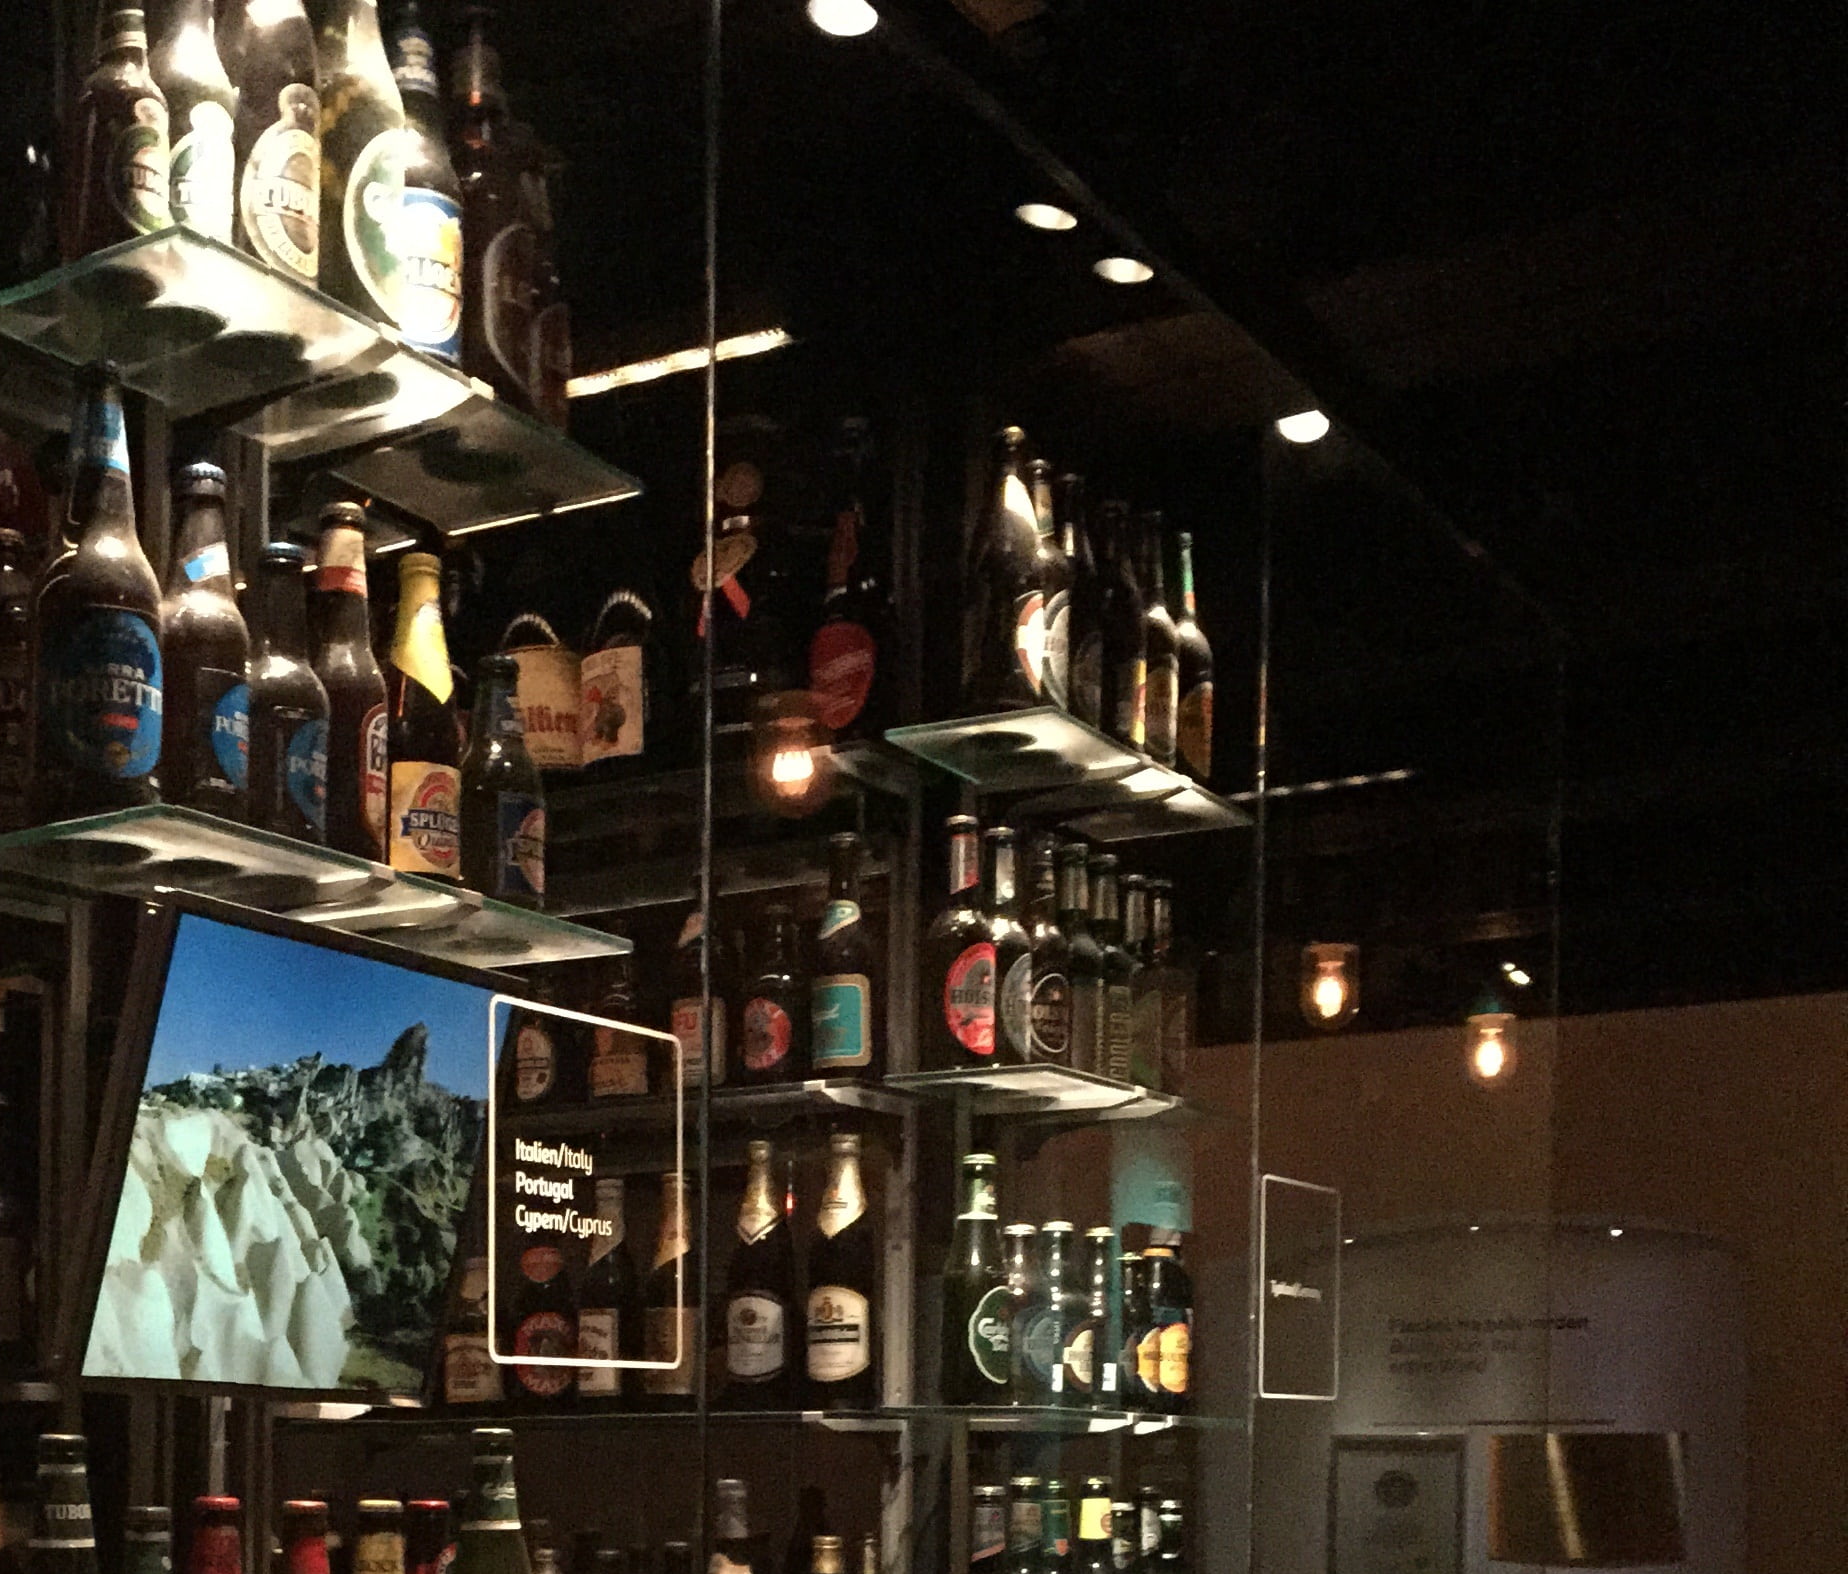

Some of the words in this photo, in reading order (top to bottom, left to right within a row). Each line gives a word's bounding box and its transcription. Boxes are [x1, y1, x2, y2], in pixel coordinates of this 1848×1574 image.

[515, 1138, 593, 1175] Italien/Italy
[515, 1171, 575, 1204] Portugal
[515, 1204, 613, 1239] Cypern/Cyprus
